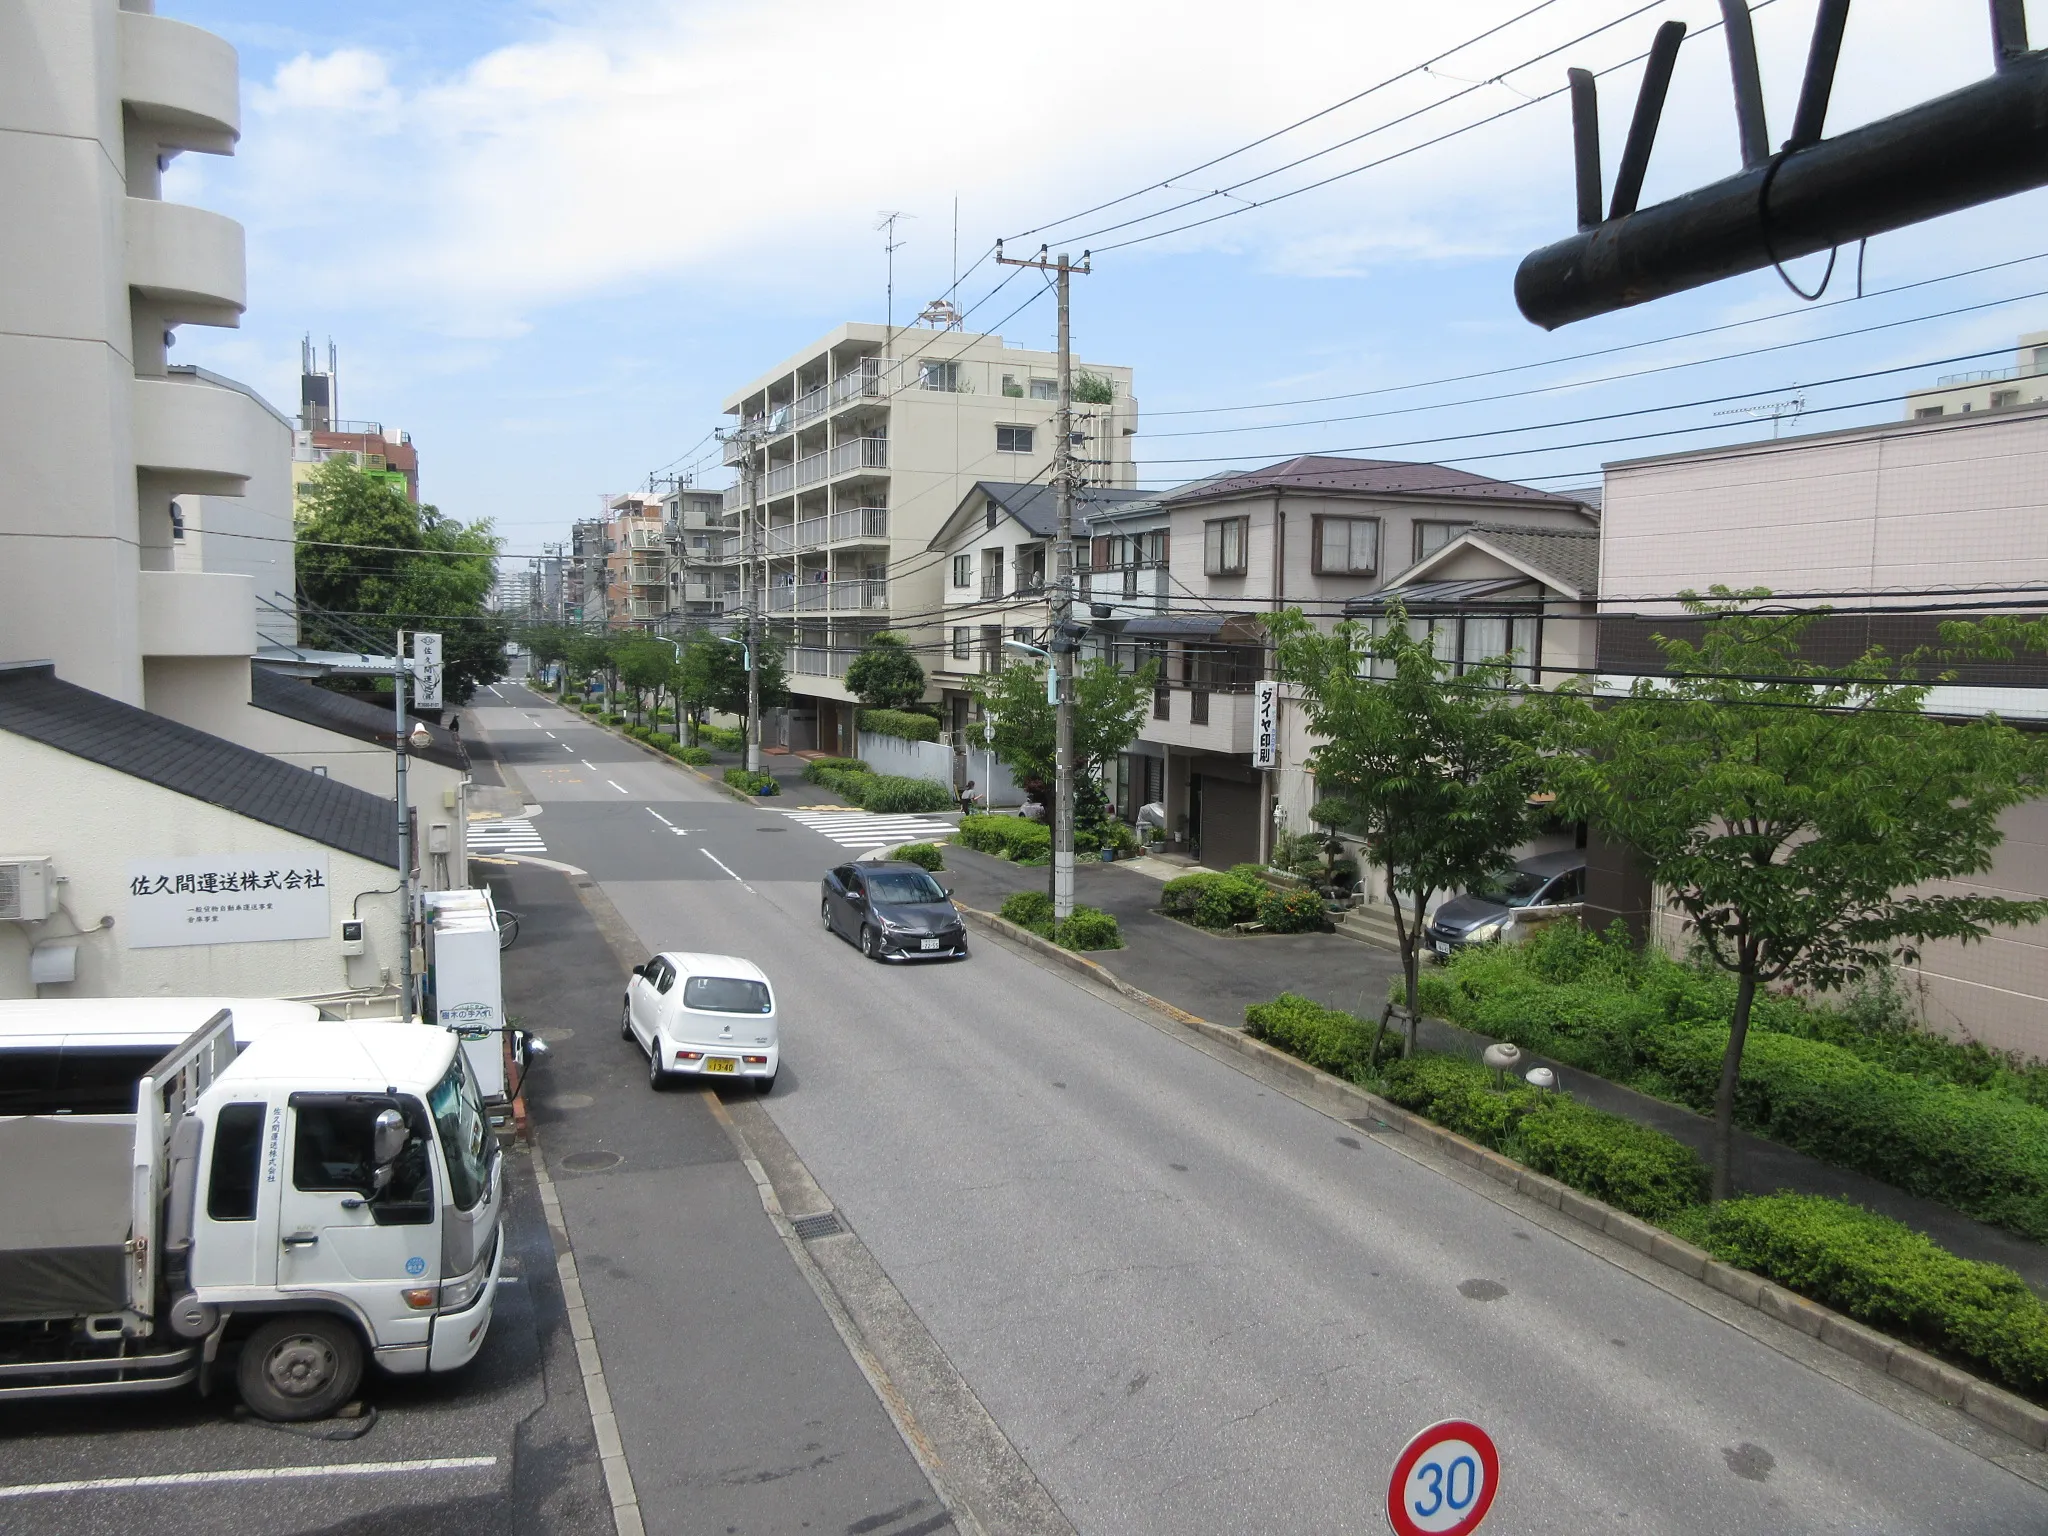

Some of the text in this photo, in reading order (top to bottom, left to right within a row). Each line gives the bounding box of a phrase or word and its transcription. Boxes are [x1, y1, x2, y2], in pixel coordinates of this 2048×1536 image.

[1259, 688, 1272, 763] ダイヤ印刷
[130, 868, 326, 896] 佐久間運送株式会社
[713, 1063, 733, 1072] 13-40
[267, 1106, 283, 1183] 佐久間運送株式会社
[1414, 1455, 1476, 1517] 30
